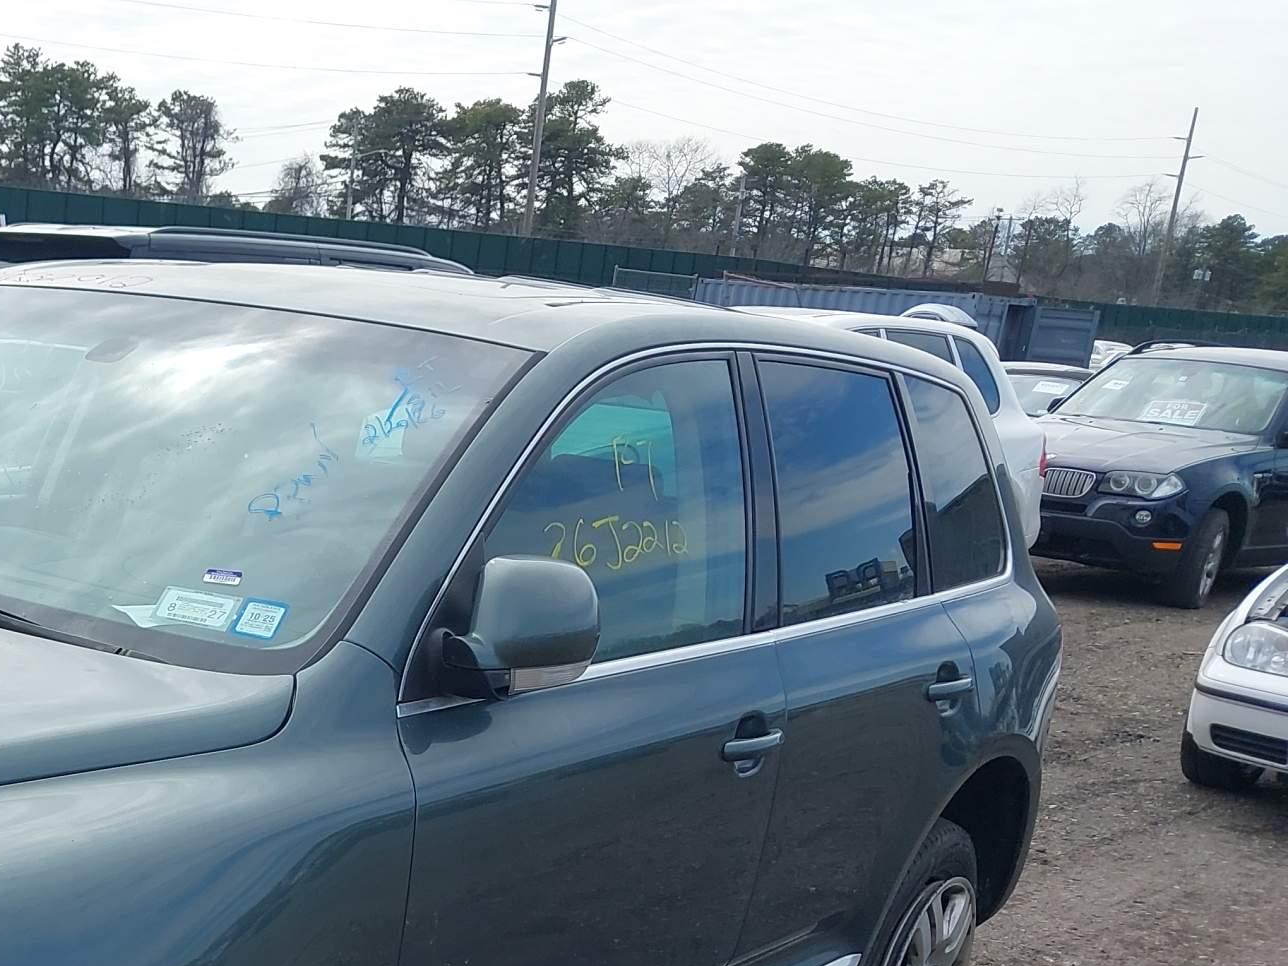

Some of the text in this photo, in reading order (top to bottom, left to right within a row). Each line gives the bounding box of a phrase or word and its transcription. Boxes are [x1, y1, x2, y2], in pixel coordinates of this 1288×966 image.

[1166, 403, 1189, 411] FOR
[1147, 408, 1201, 419] SALE
[207, 609, 227, 620] 27
